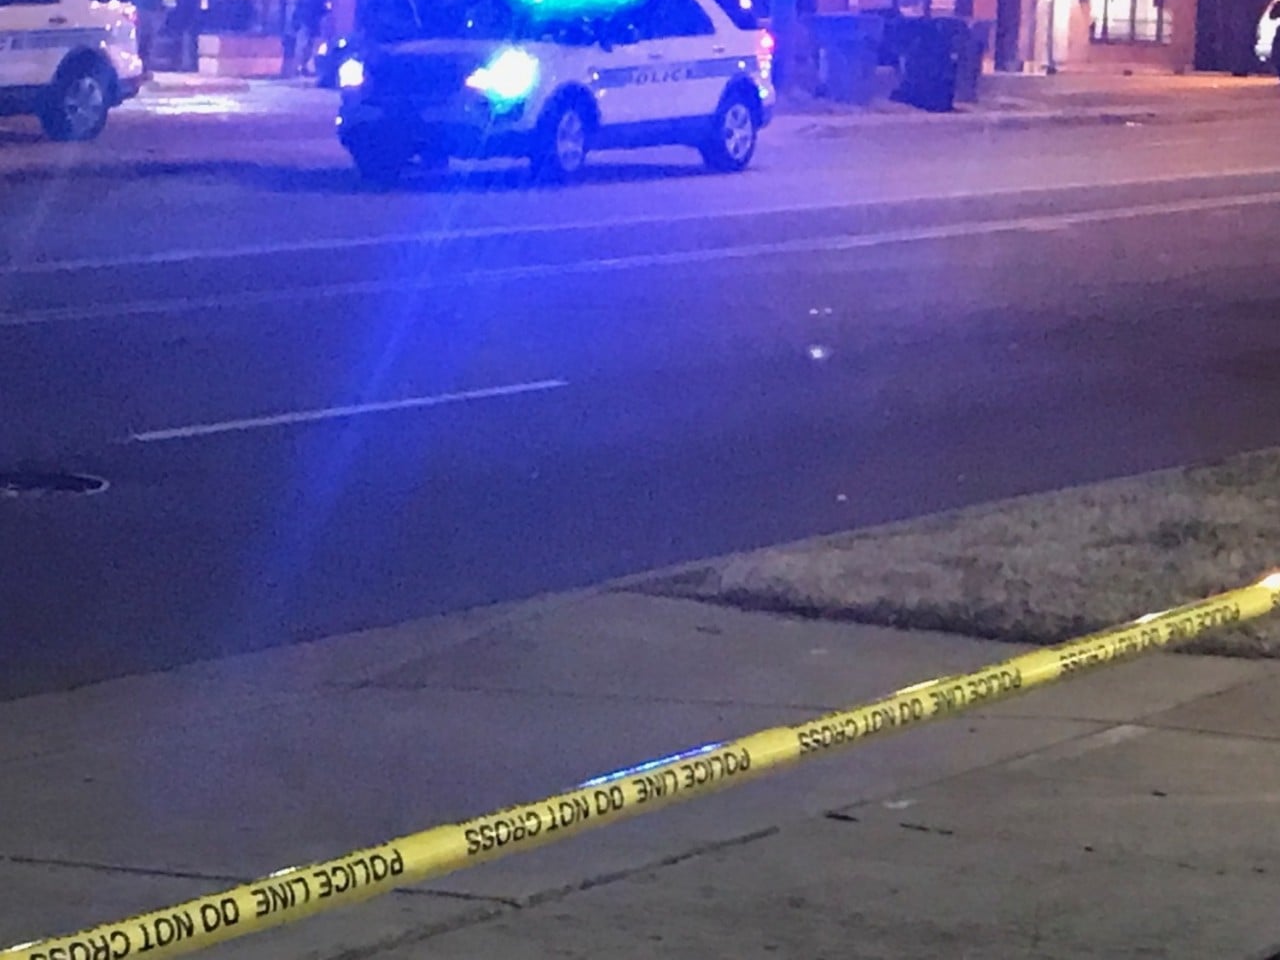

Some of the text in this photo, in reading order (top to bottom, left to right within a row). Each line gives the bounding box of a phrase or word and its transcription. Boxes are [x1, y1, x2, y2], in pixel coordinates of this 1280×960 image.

[798, 668, 1022, 753] POLICE LINE DO NOT CROSS
[465, 748, 751, 856] POLICE LINE DO NOT CROSS
[29, 848, 404, 960] POLICE LINE DO NOT CRO
